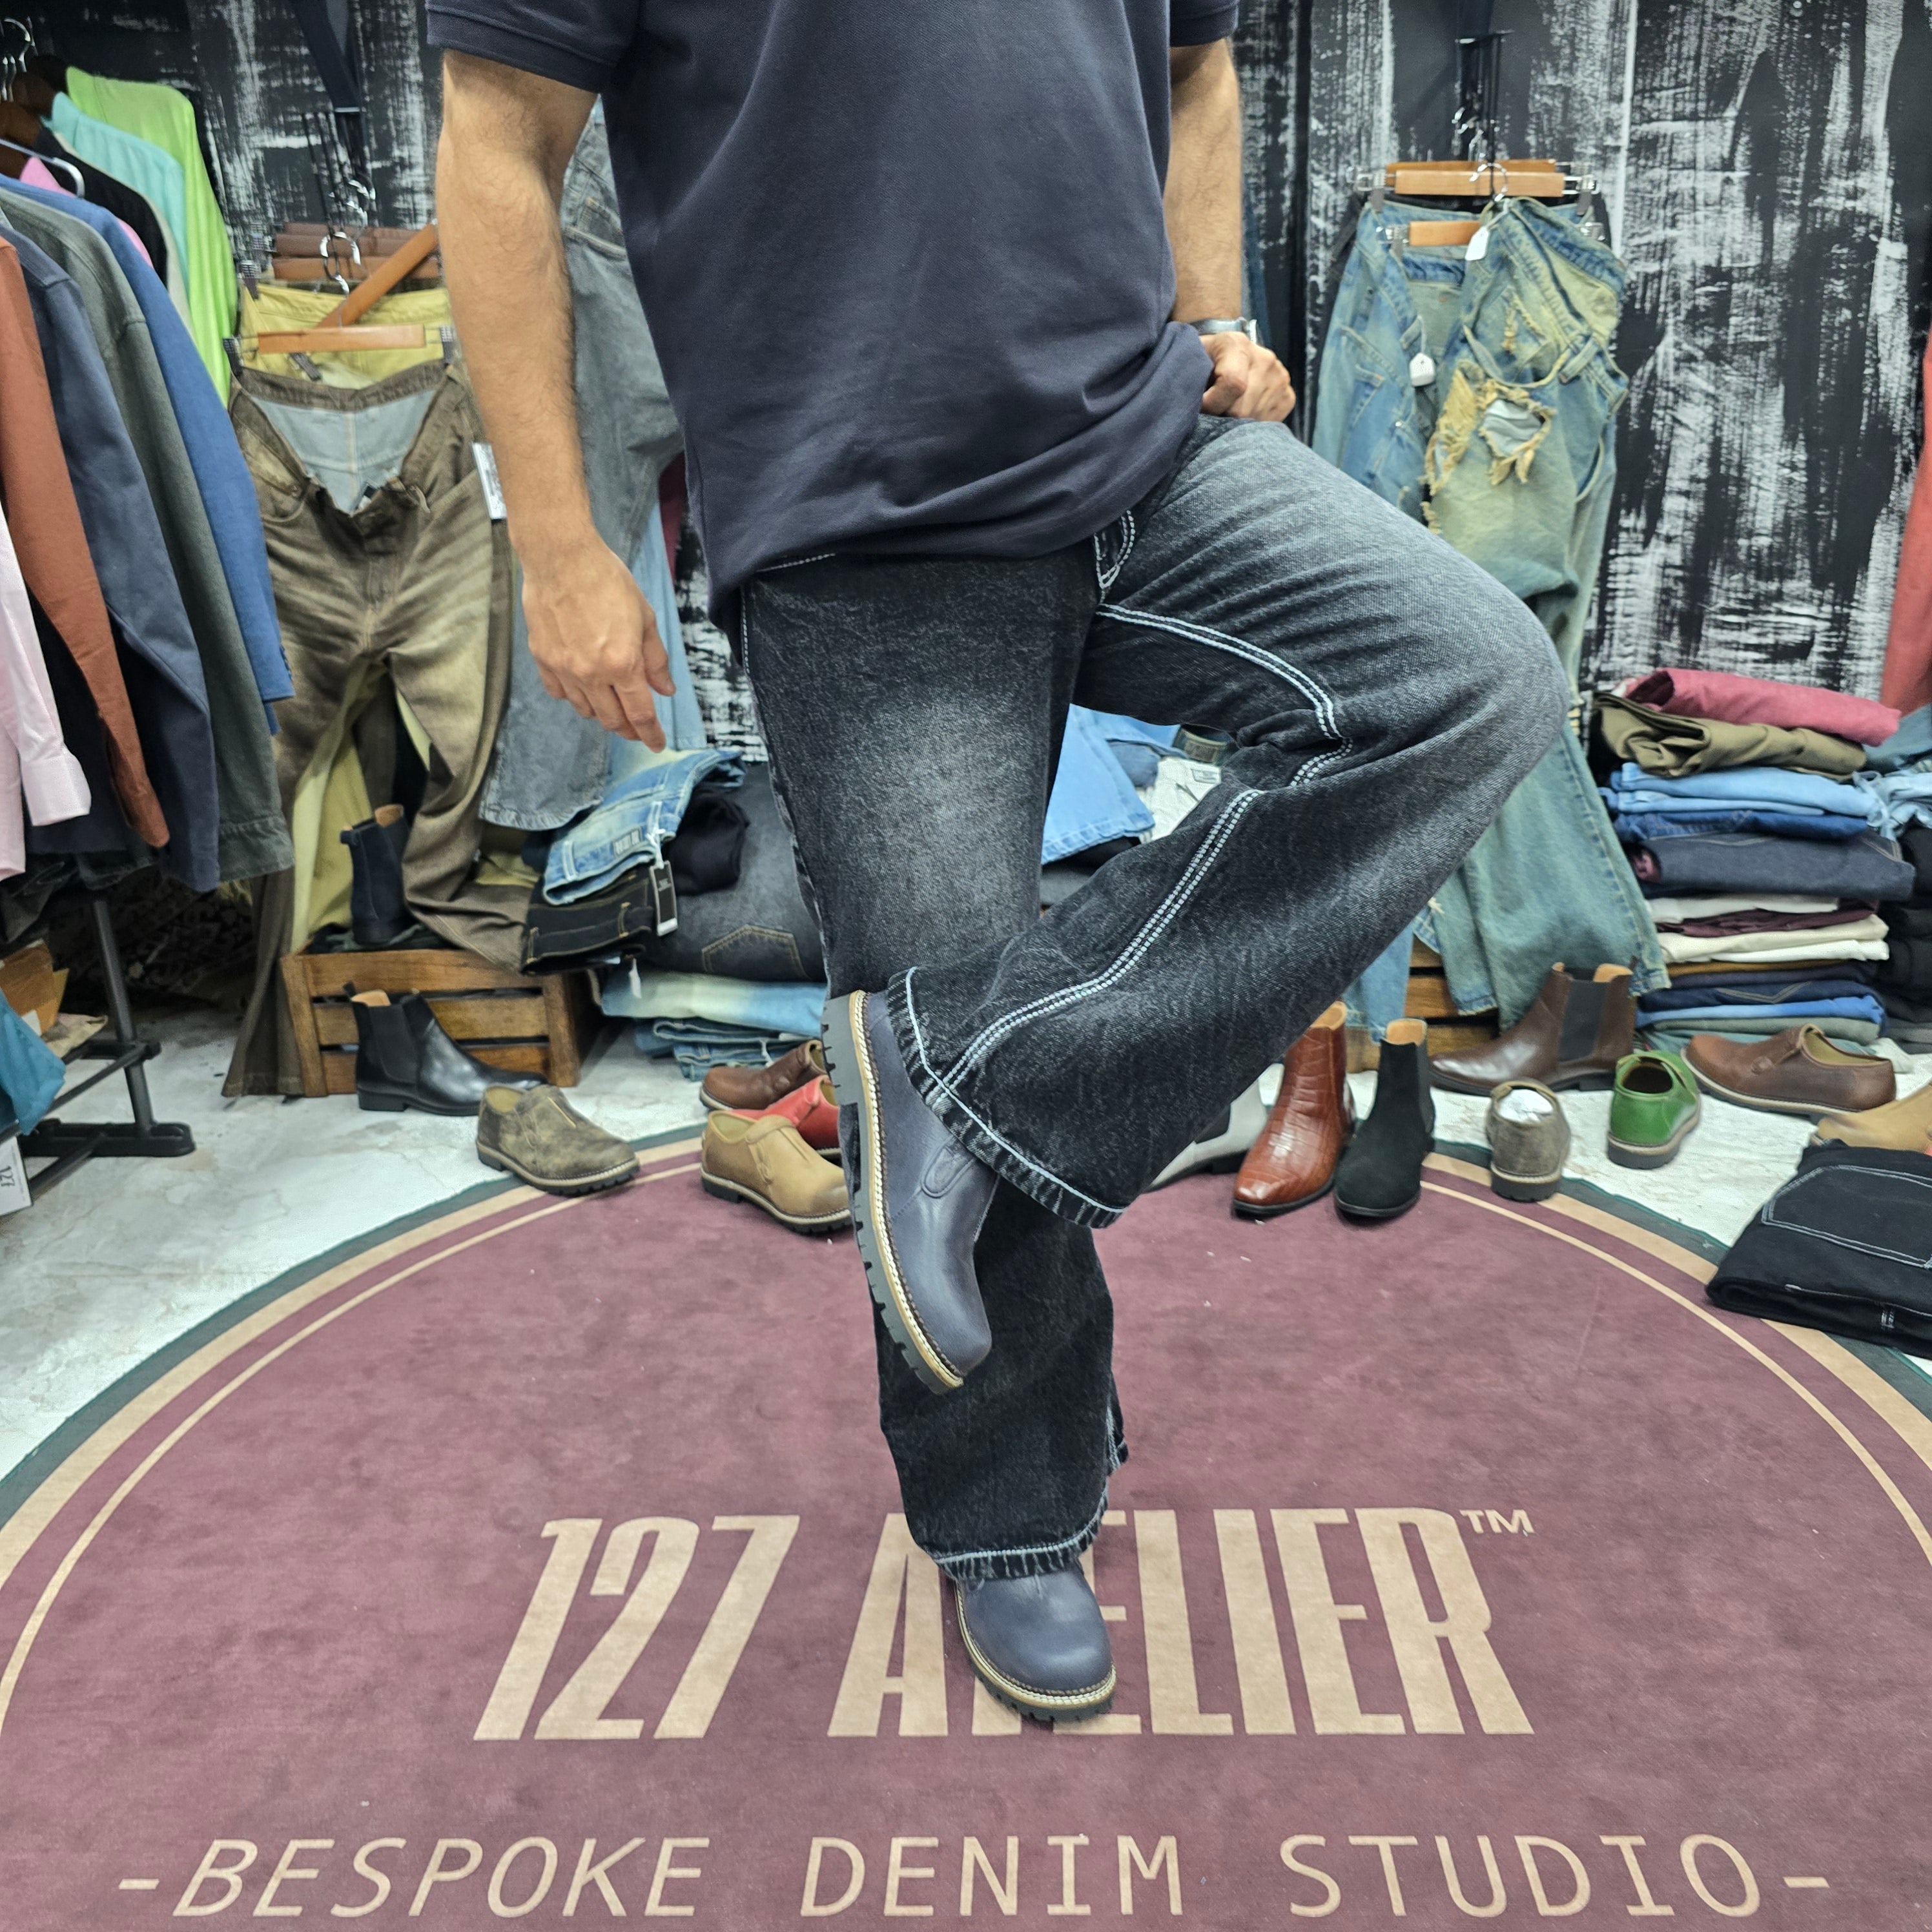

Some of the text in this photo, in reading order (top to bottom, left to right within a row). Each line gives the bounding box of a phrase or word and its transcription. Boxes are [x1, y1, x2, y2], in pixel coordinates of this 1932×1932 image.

[473, 1515, 801, 1741] 127
[827, 1507, 1534, 1737] ALIER
[801, 1835, 1182, 1917] DENIM
